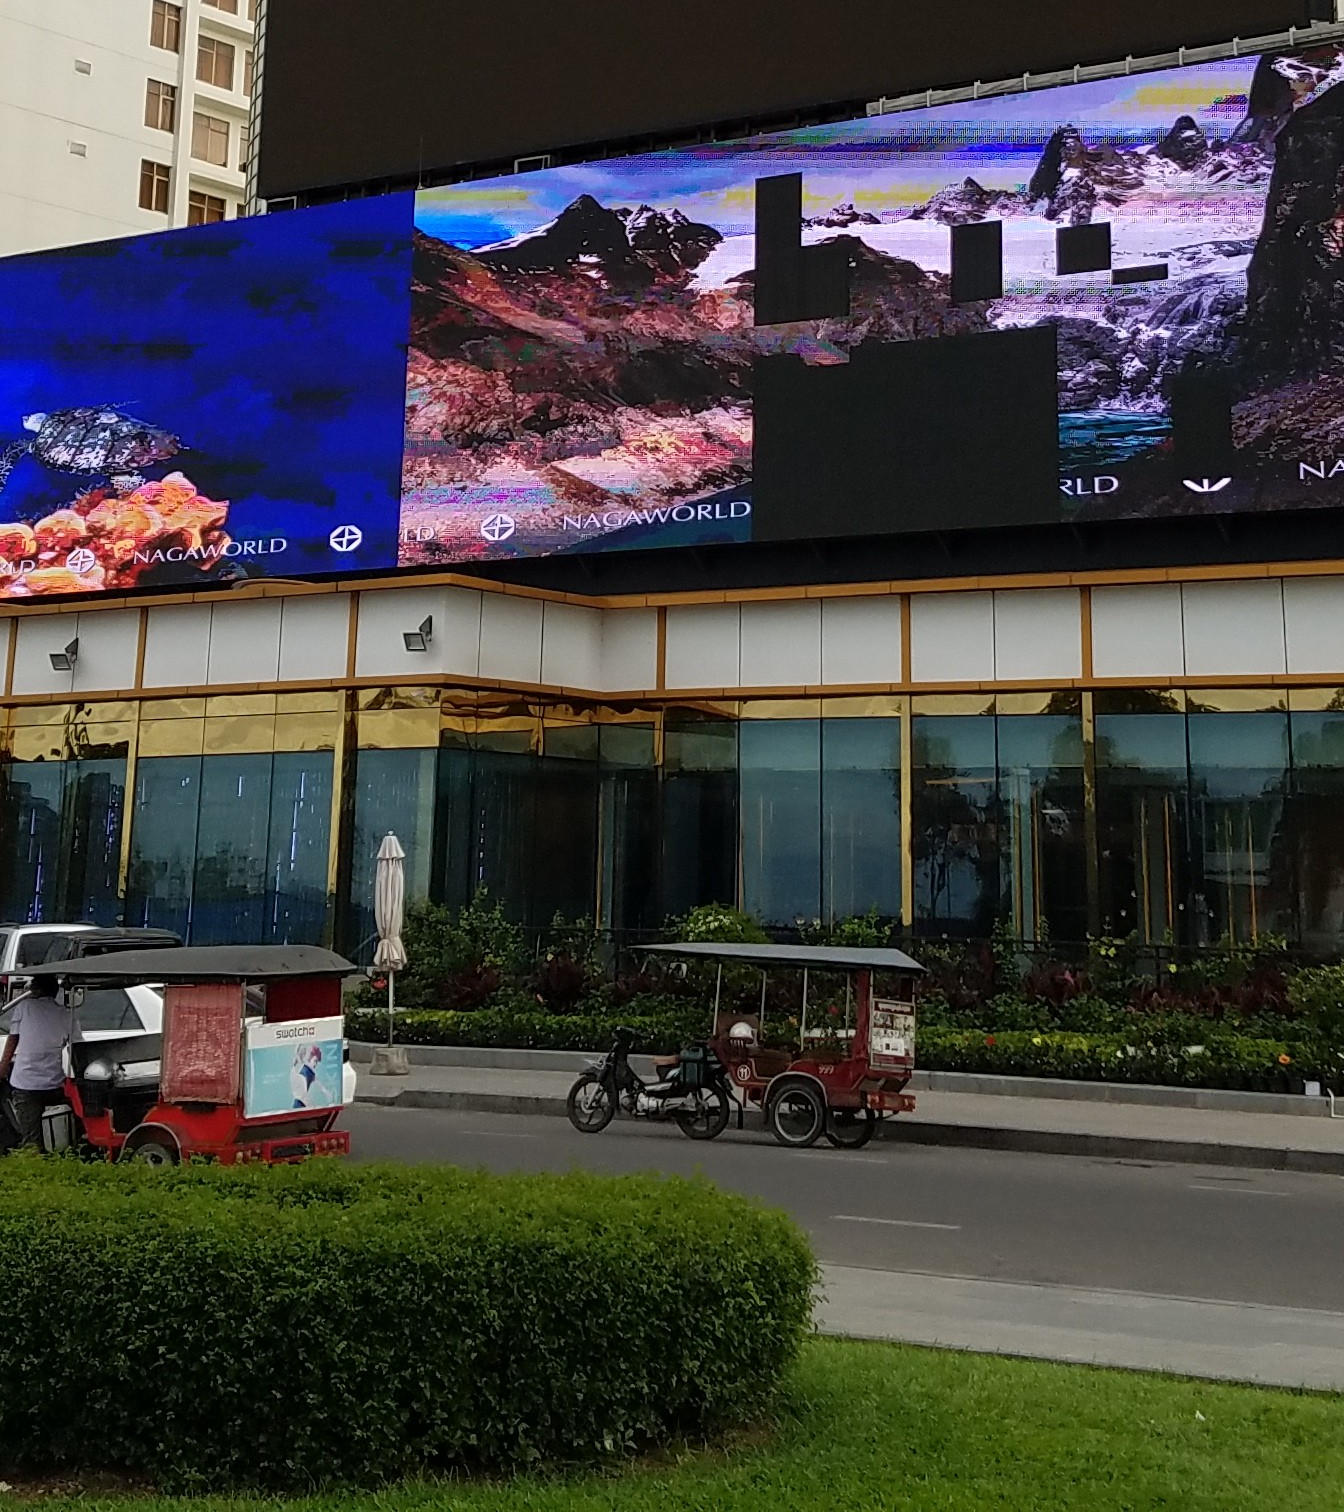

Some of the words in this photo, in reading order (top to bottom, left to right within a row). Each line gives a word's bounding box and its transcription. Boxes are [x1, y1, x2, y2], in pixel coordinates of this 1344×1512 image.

[562, 500, 752, 531] NAGAWORLD
[133, 538, 288, 565] NAGAWORLD
[276, 1027, 309, 1039] swatch
